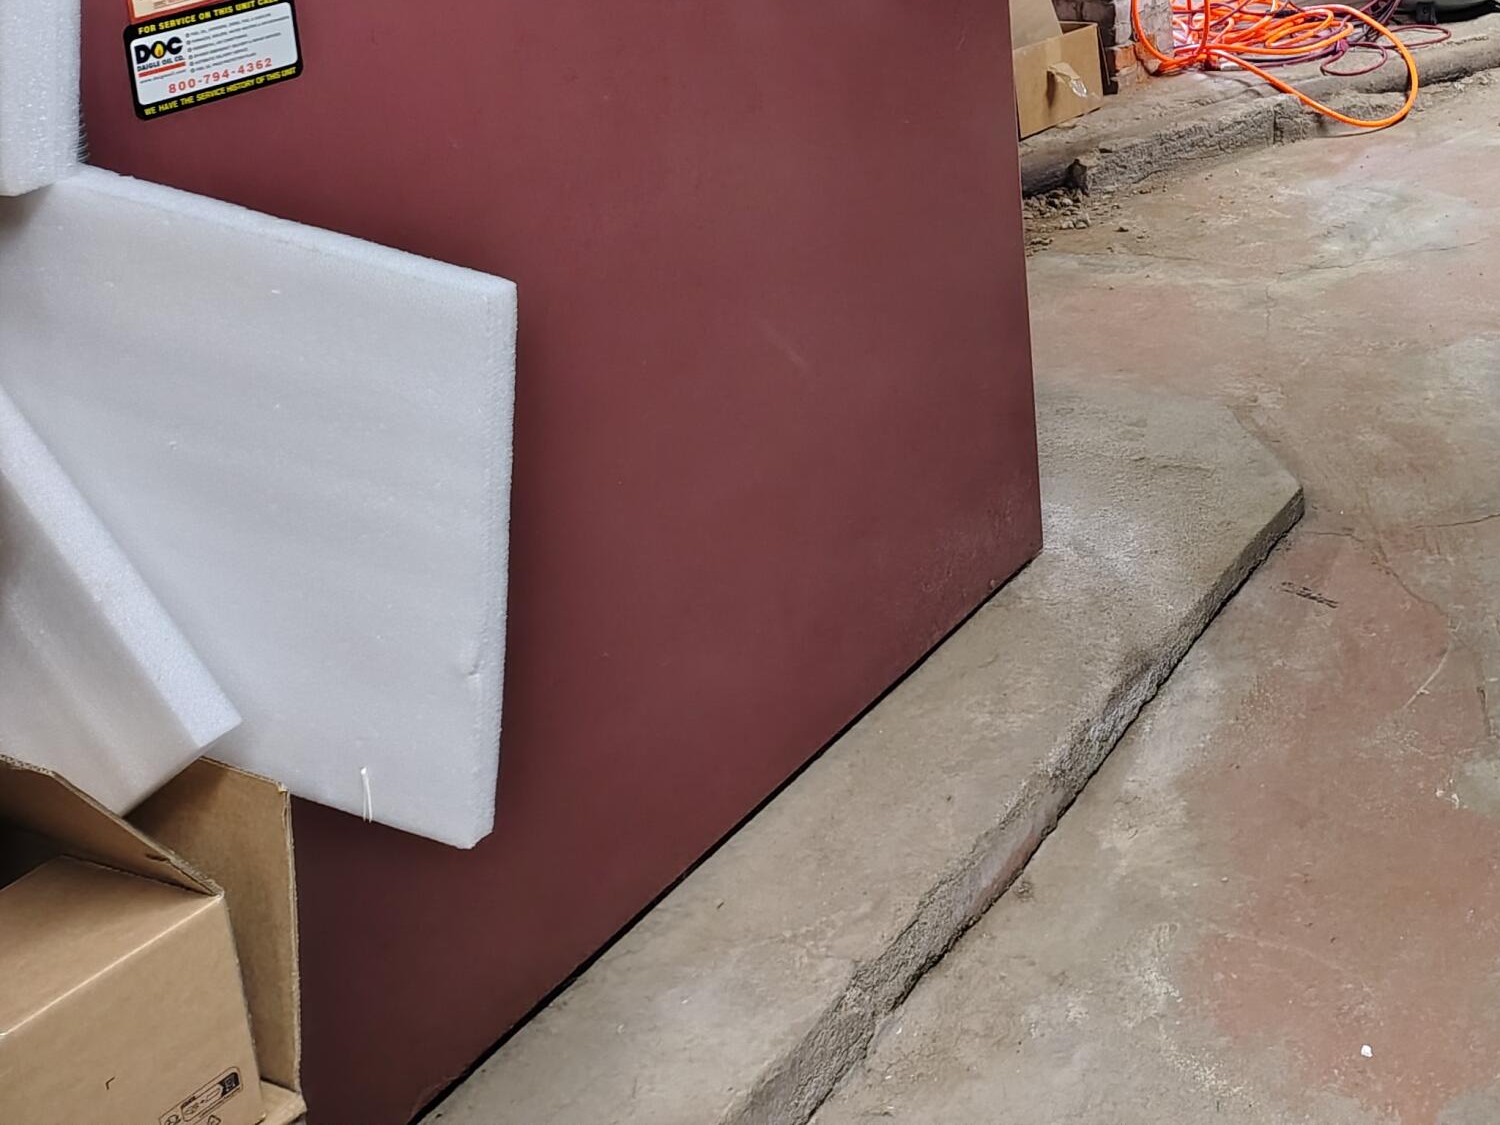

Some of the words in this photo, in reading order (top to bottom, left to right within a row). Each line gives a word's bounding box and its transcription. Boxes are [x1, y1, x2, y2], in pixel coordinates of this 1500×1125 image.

[138, 24, 157, 35] FOR
[158, 14, 197, 30] SERVICE
[198, 10, 212, 21] ON
[213, 5, 234, 17] THIS
[235, 1, 257, 11] UNIT
[134, 36, 183, 64] DOC
[137, 61, 160, 72] DAIGLE
[144, 106, 157, 116] WE
[158, 100, 179, 113] HAVE
[180, 95, 195, 105] THE
[196, 86, 226, 102] SERVICE
[226, 79, 255, 94] HISTORY
[255, 76, 266, 86] OF
[266, 71, 281, 82] THIS
[281, 66, 296, 78] UNIT
[168, 57, 273, 94] 800-794-4362
